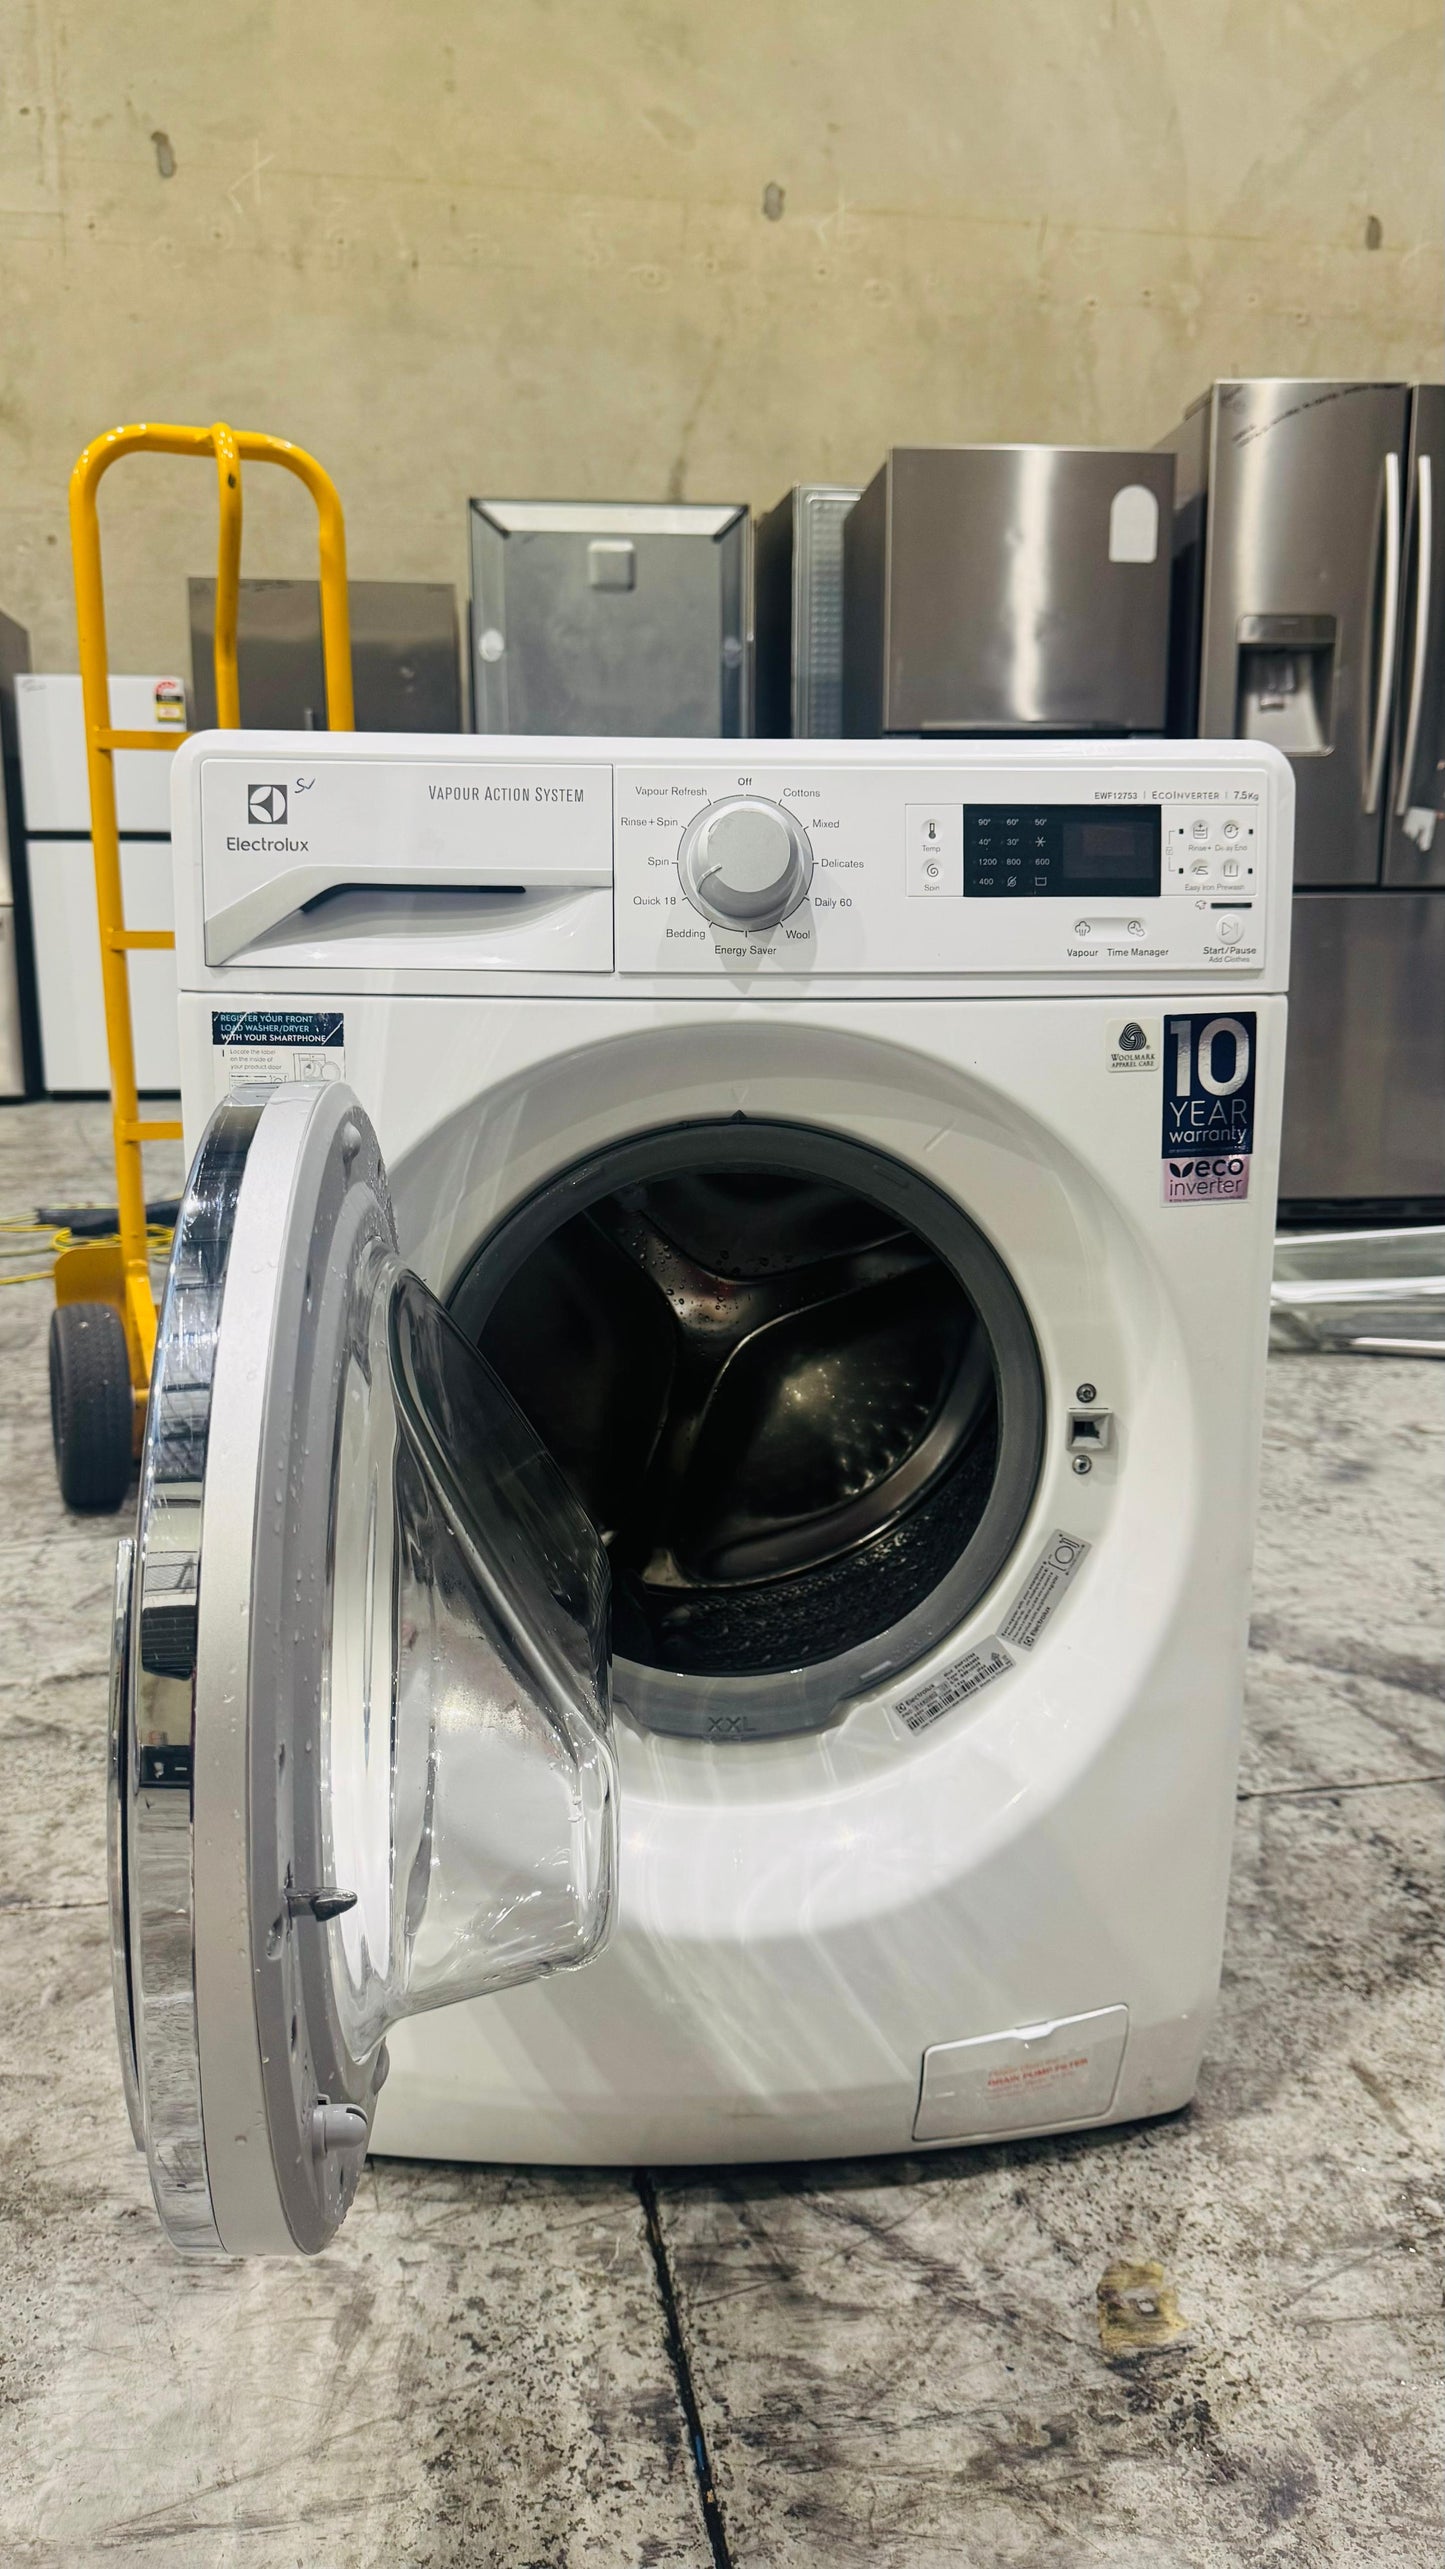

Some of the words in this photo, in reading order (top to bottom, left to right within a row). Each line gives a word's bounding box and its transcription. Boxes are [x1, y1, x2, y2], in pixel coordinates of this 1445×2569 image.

[737, 777, 753, 787] Off
[635, 786, 668, 796] Vapour
[671, 786, 708, 796] Refresh
[783, 788, 821, 798] Cottons
[1094, 792, 1138, 800] EWF12753
[812, 819, 840, 829] Mixed
[226, 837, 309, 852] Electrolux
[922, 844, 941, 853] Temp
[1215, 844, 1233, 852] Day
[647, 857, 670, 868] Spin
[821, 858, 864, 868] Delicates
[979, 858, 997, 866] 1200
[1006, 858, 1021, 866] 800
[1035, 858, 1050, 866] 600
[924, 884, 940, 892] Spin
[633, 896, 661, 906] Quick
[664, 896, 677, 905] 18
[815, 897, 837, 909] Daily
[839, 898, 853, 907] 60
[666, 928, 706, 940] Bedding
[786, 930, 811, 939] Wool
[714, 945, 747, 957] Energy
[749, 945, 777, 955] Saver
[1067, 949, 1099, 958] Vapour
[1107, 948, 1129, 957] Time
[1131, 948, 1169, 958] Manager
[1203, 946, 1257, 955] Start/Pause
[285, 1015, 313, 1023] FRONT
[220, 1024, 243, 1032] LOAD
[245, 1024, 310, 1033] WASHER/DRYER
[221, 1033, 243, 1041] WITH
[244, 1034, 267, 1042] YOUR
[269, 1034, 326, 1042] SMARTPHONE
[1111, 1053, 1155, 1061] WOOLMARK
[1170, 1018, 1249, 1096] 10
[1170, 1099, 1248, 1128] YEAR
[1169, 1125, 1247, 1144] warranty
[1195, 1158, 1244, 1177] eco
[1169, 1178, 1243, 1196] inverter
[708, 1716, 757, 1732] XXL
